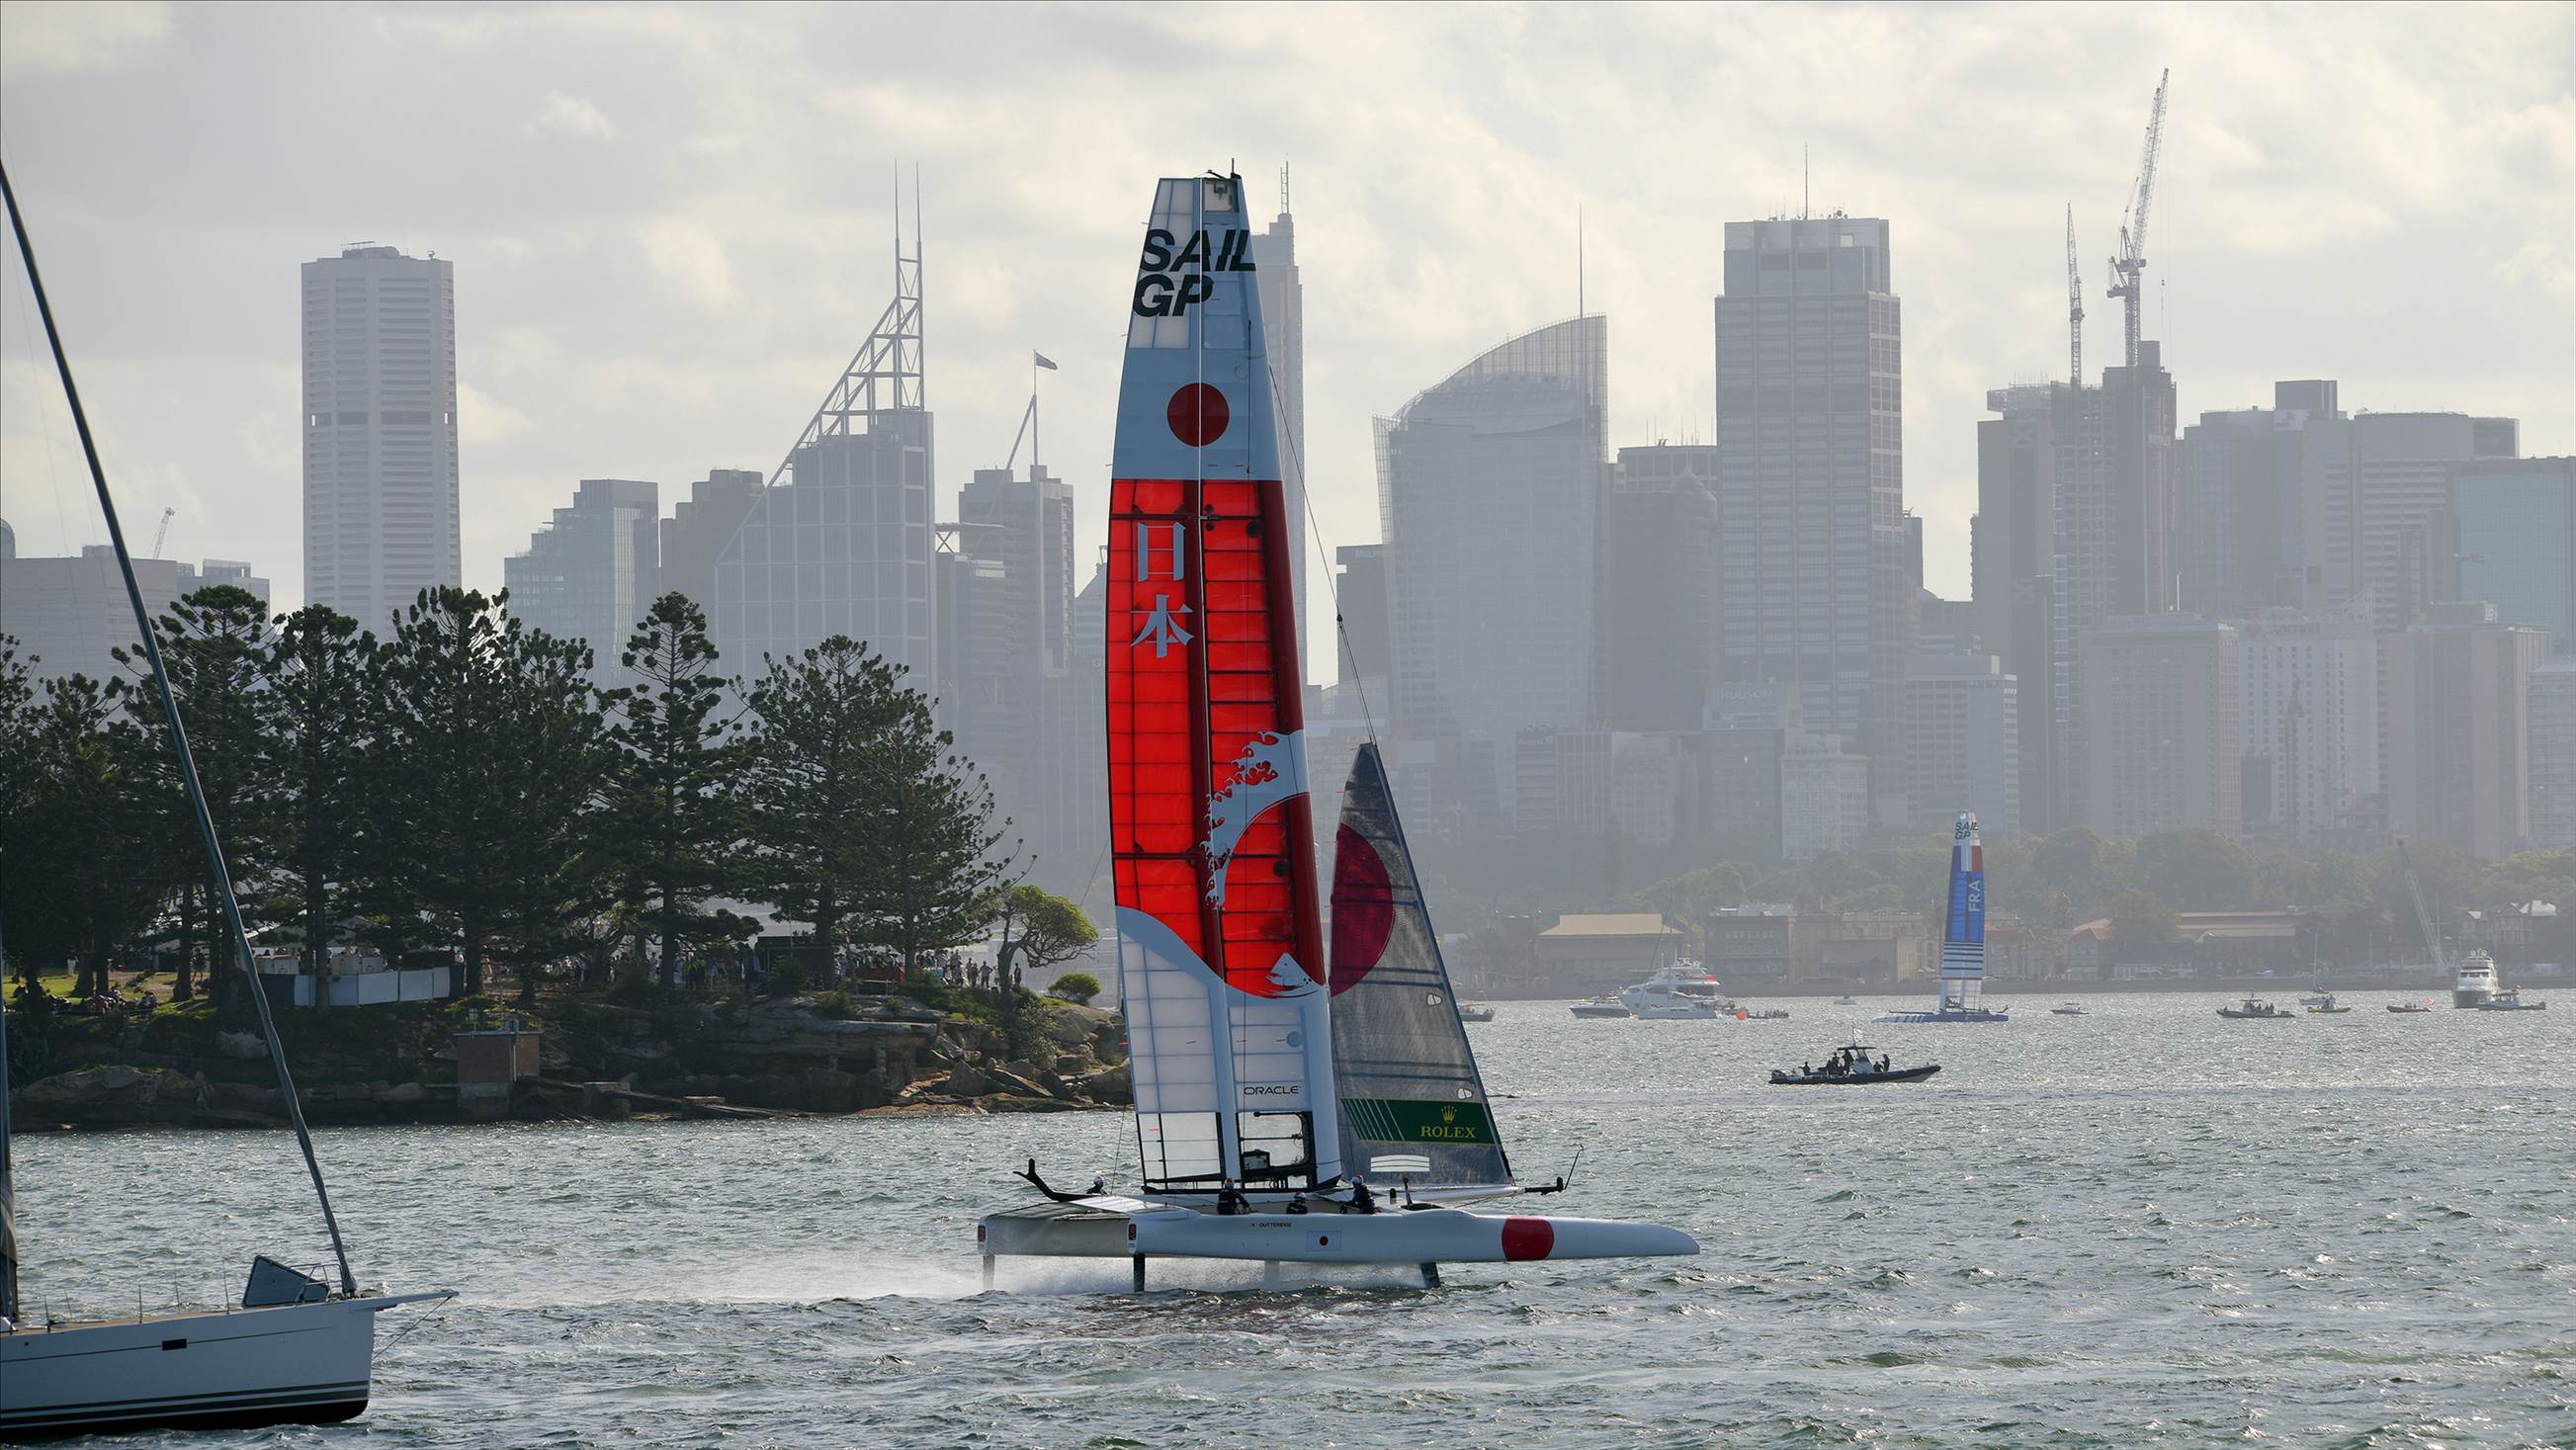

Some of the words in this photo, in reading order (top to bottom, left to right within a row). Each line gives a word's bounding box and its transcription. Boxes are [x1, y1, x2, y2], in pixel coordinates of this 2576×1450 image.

[1140, 228, 1256, 272] SAIL
[1133, 274, 1214, 317] GP
[1130, 521, 1194, 658] 日本
[1954, 821, 1979, 831] SAIL
[1954, 830, 1971, 840] GP
[1968, 880, 1981, 912] FRA
[1244, 1085, 1300, 1095] ORACLE
[1420, 1126, 1477, 1139] ROLEX
